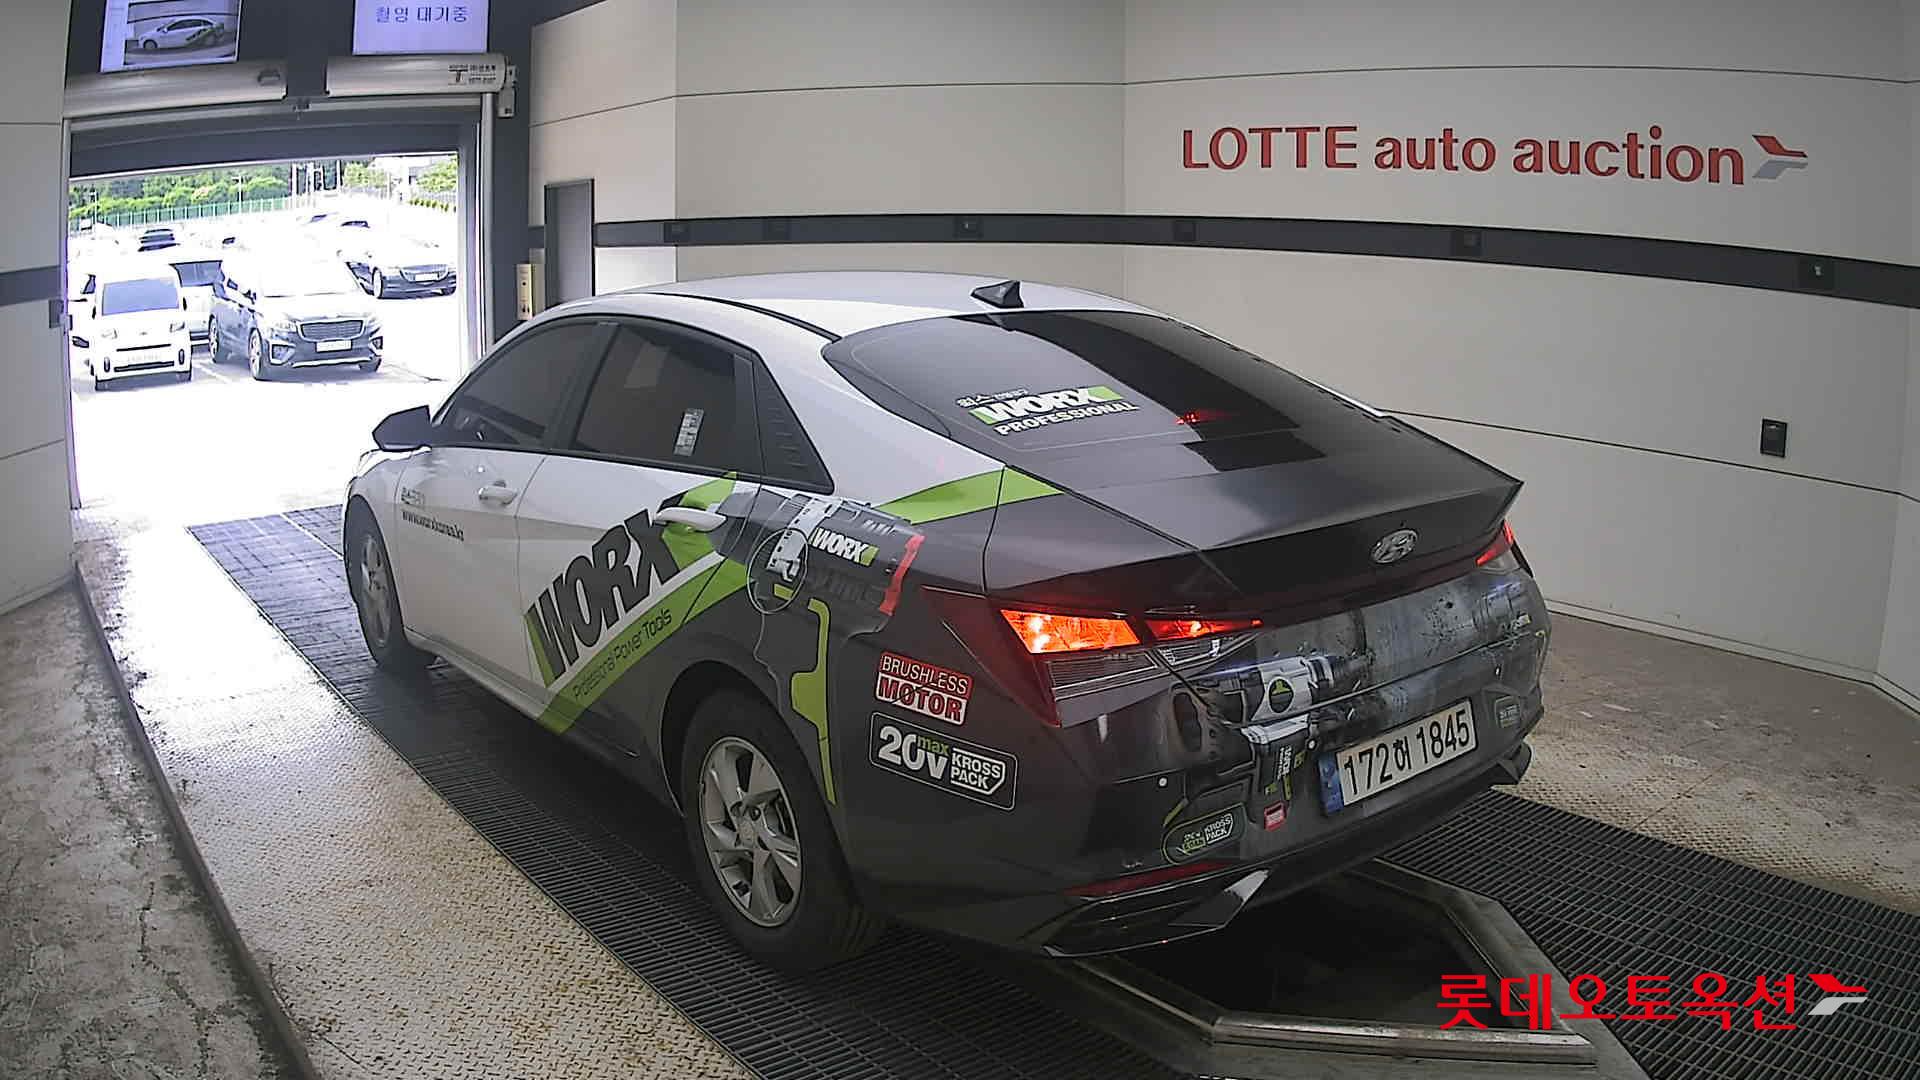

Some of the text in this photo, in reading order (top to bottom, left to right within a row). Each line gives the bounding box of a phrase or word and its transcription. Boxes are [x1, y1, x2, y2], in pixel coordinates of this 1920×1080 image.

[417, 6, 468, 23] 대기중
[1182, 125, 1745, 185] LOTTE auto auction
[977, 386, 1105, 422] WORX
[994, 401, 1141, 436] PROFESSIONAL
[811, 527, 870, 563] WORX
[530, 491, 687, 681] WORX
[614, 629, 643, 660] Power
[641, 607, 673, 639] Tools
[882, 655, 969, 695] BRUSHLESS
[878, 677, 963, 723] MOTOR
[917, 735, 950, 757] max
[1344, 736, 1412, 796] 172허
[1415, 708, 1470, 765] 1845
[950, 766, 989, 790] PACK
[951, 752, 1002, 779] KROSS
